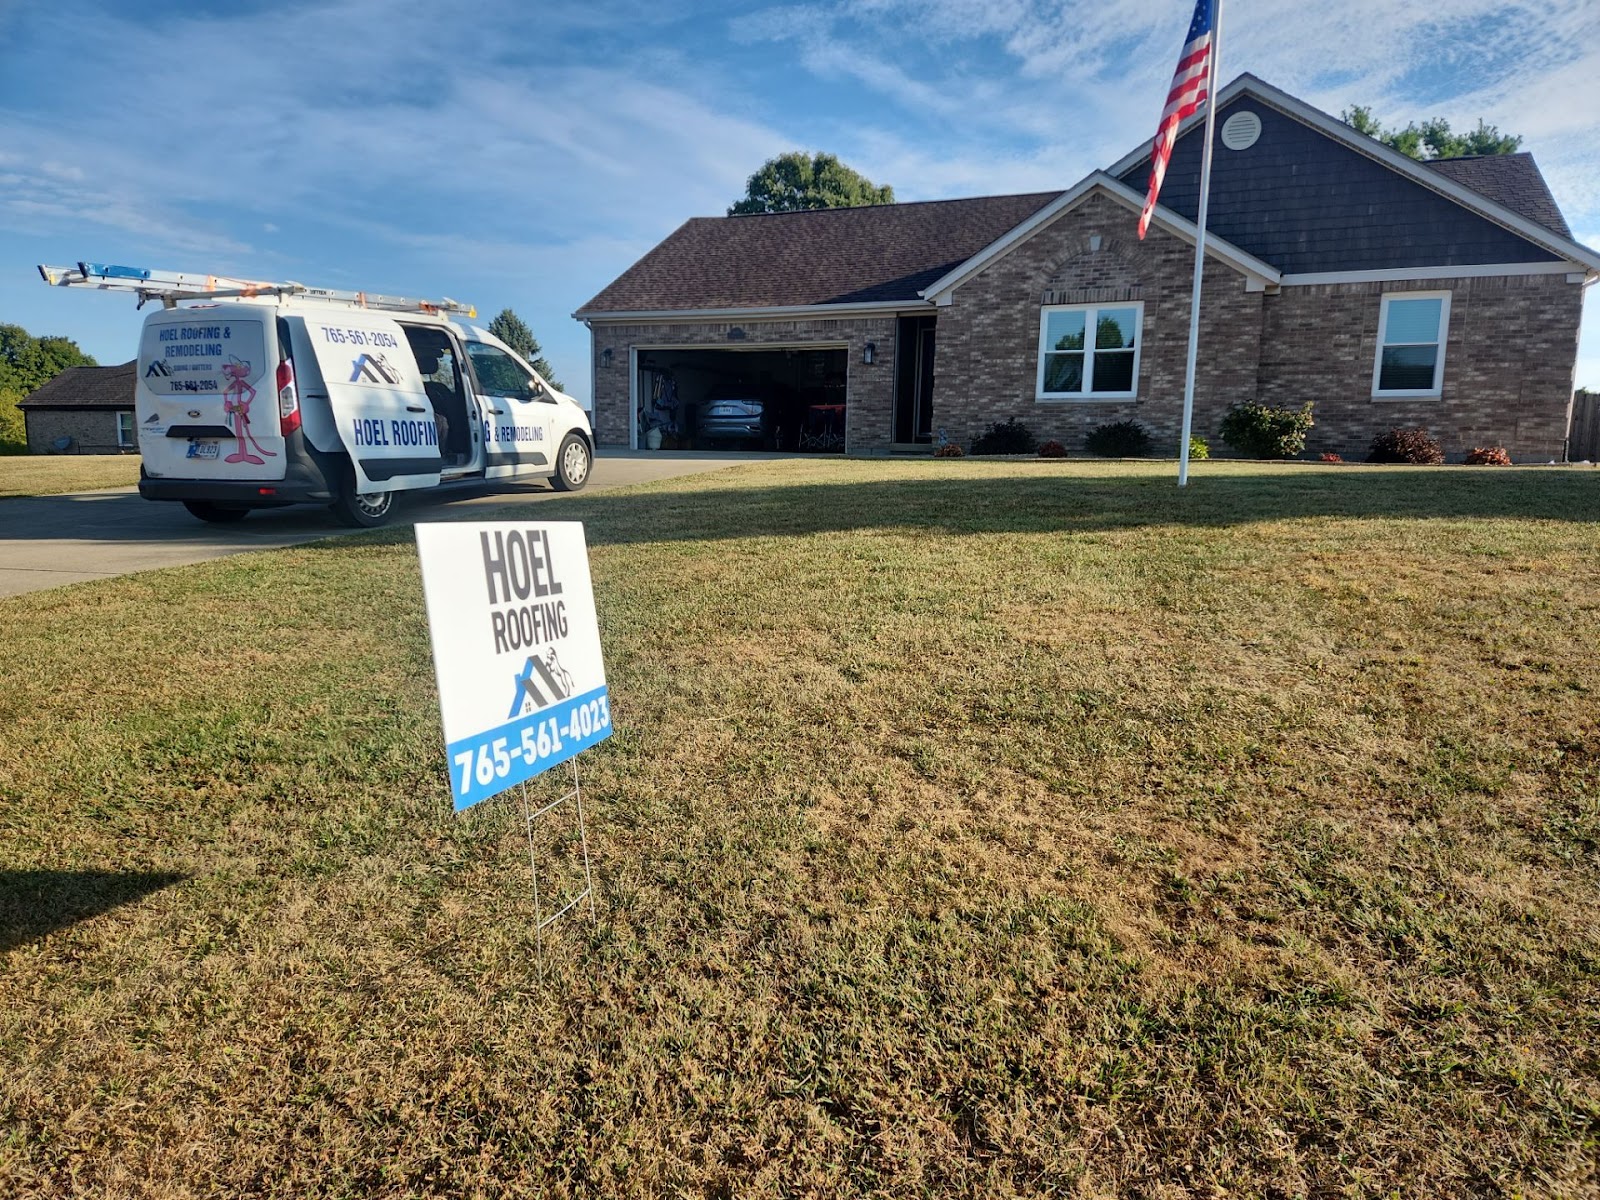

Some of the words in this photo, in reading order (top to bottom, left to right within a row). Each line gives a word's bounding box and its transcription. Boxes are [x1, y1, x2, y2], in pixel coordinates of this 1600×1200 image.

[160, 329, 179, 341] HOEL
[181, 327, 220, 340] ROOFING
[223, 326, 231, 339] &
[321, 327, 398, 348] 765-561-2054
[165, 343, 222, 357] REMODELING
[353, 419, 389, 446] HOEL
[494, 426, 500, 442] &
[501, 426, 544, 442] REMODELING
[480, 530, 563, 604] HOEL
[491, 600, 568, 655] ROOFING
[454, 695, 609, 795] 765-561-4023
